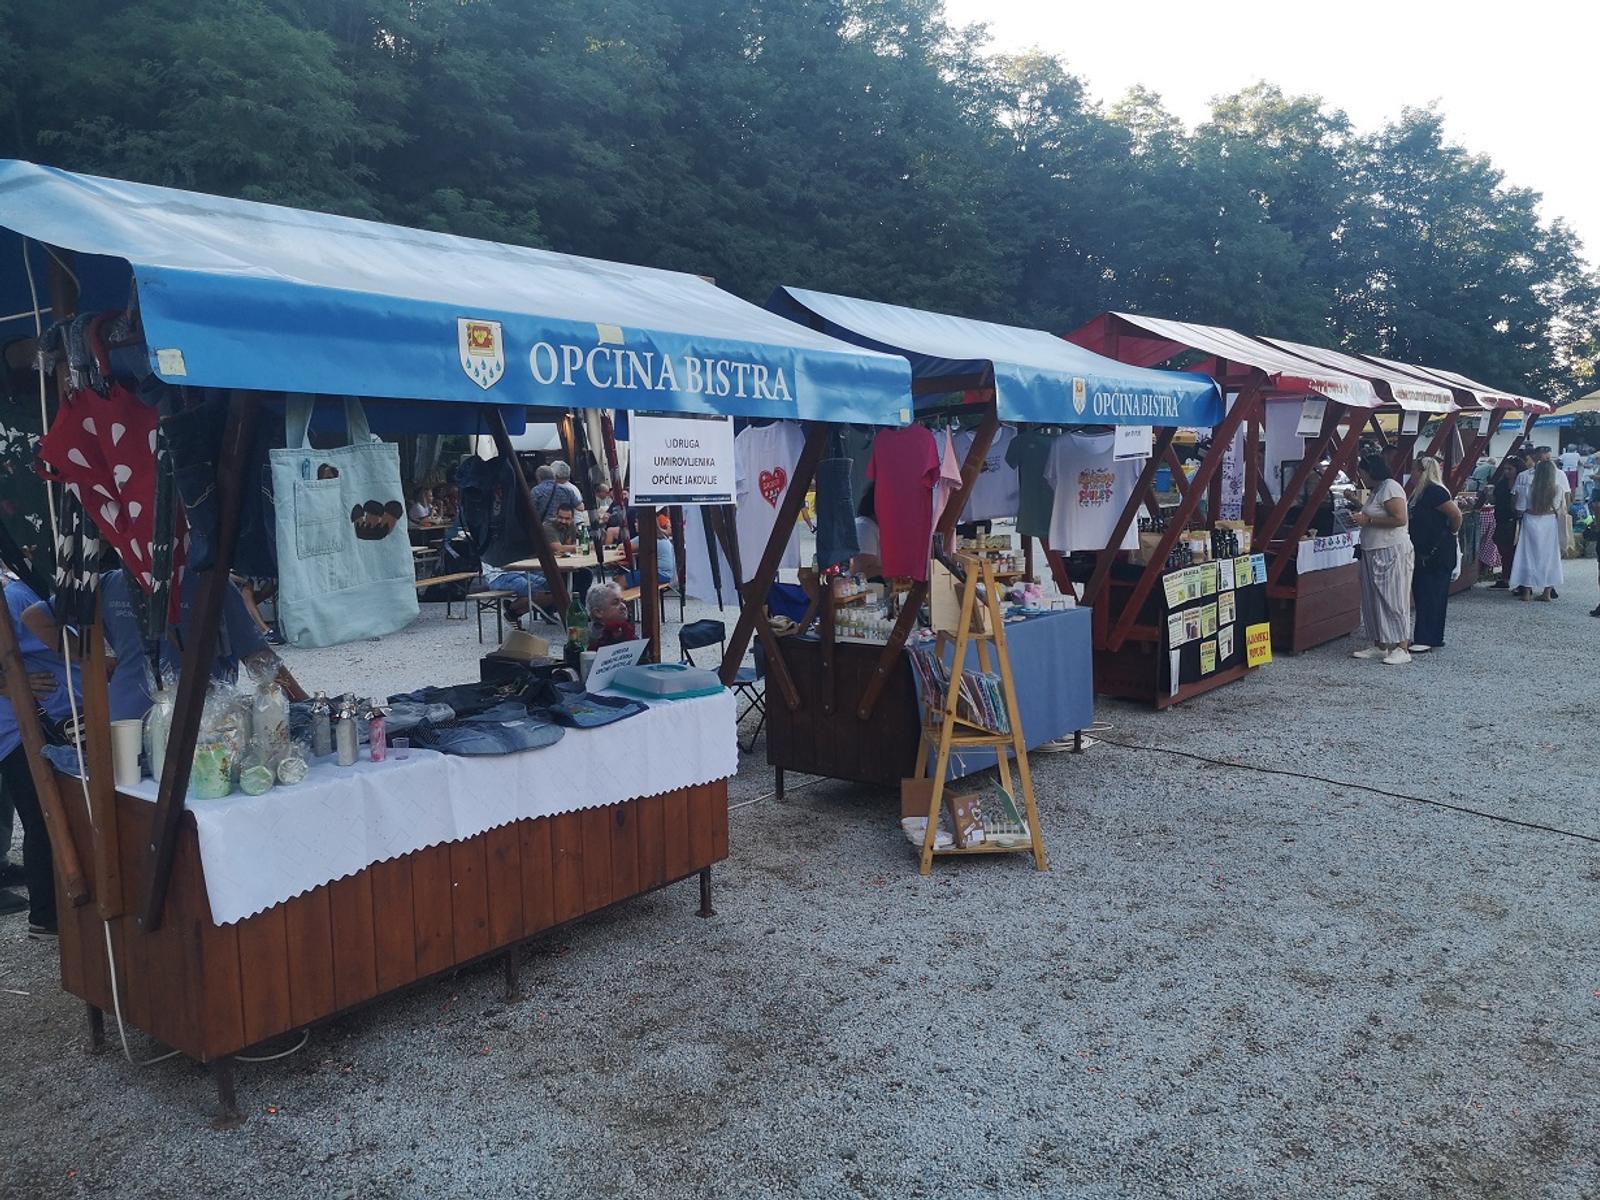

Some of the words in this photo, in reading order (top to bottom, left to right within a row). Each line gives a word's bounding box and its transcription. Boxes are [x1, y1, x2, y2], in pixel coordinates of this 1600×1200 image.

[684, 356, 793, 402] BISTRA
[1141, 395, 1179, 417] BISTRA
[664, 438, 700, 449] UDRUGA
[653, 456, 716, 467] UMIROVLJENIKA
[651, 473, 683, 485] OPĆINE
[684, 475, 718, 485] JAKOVLJE
